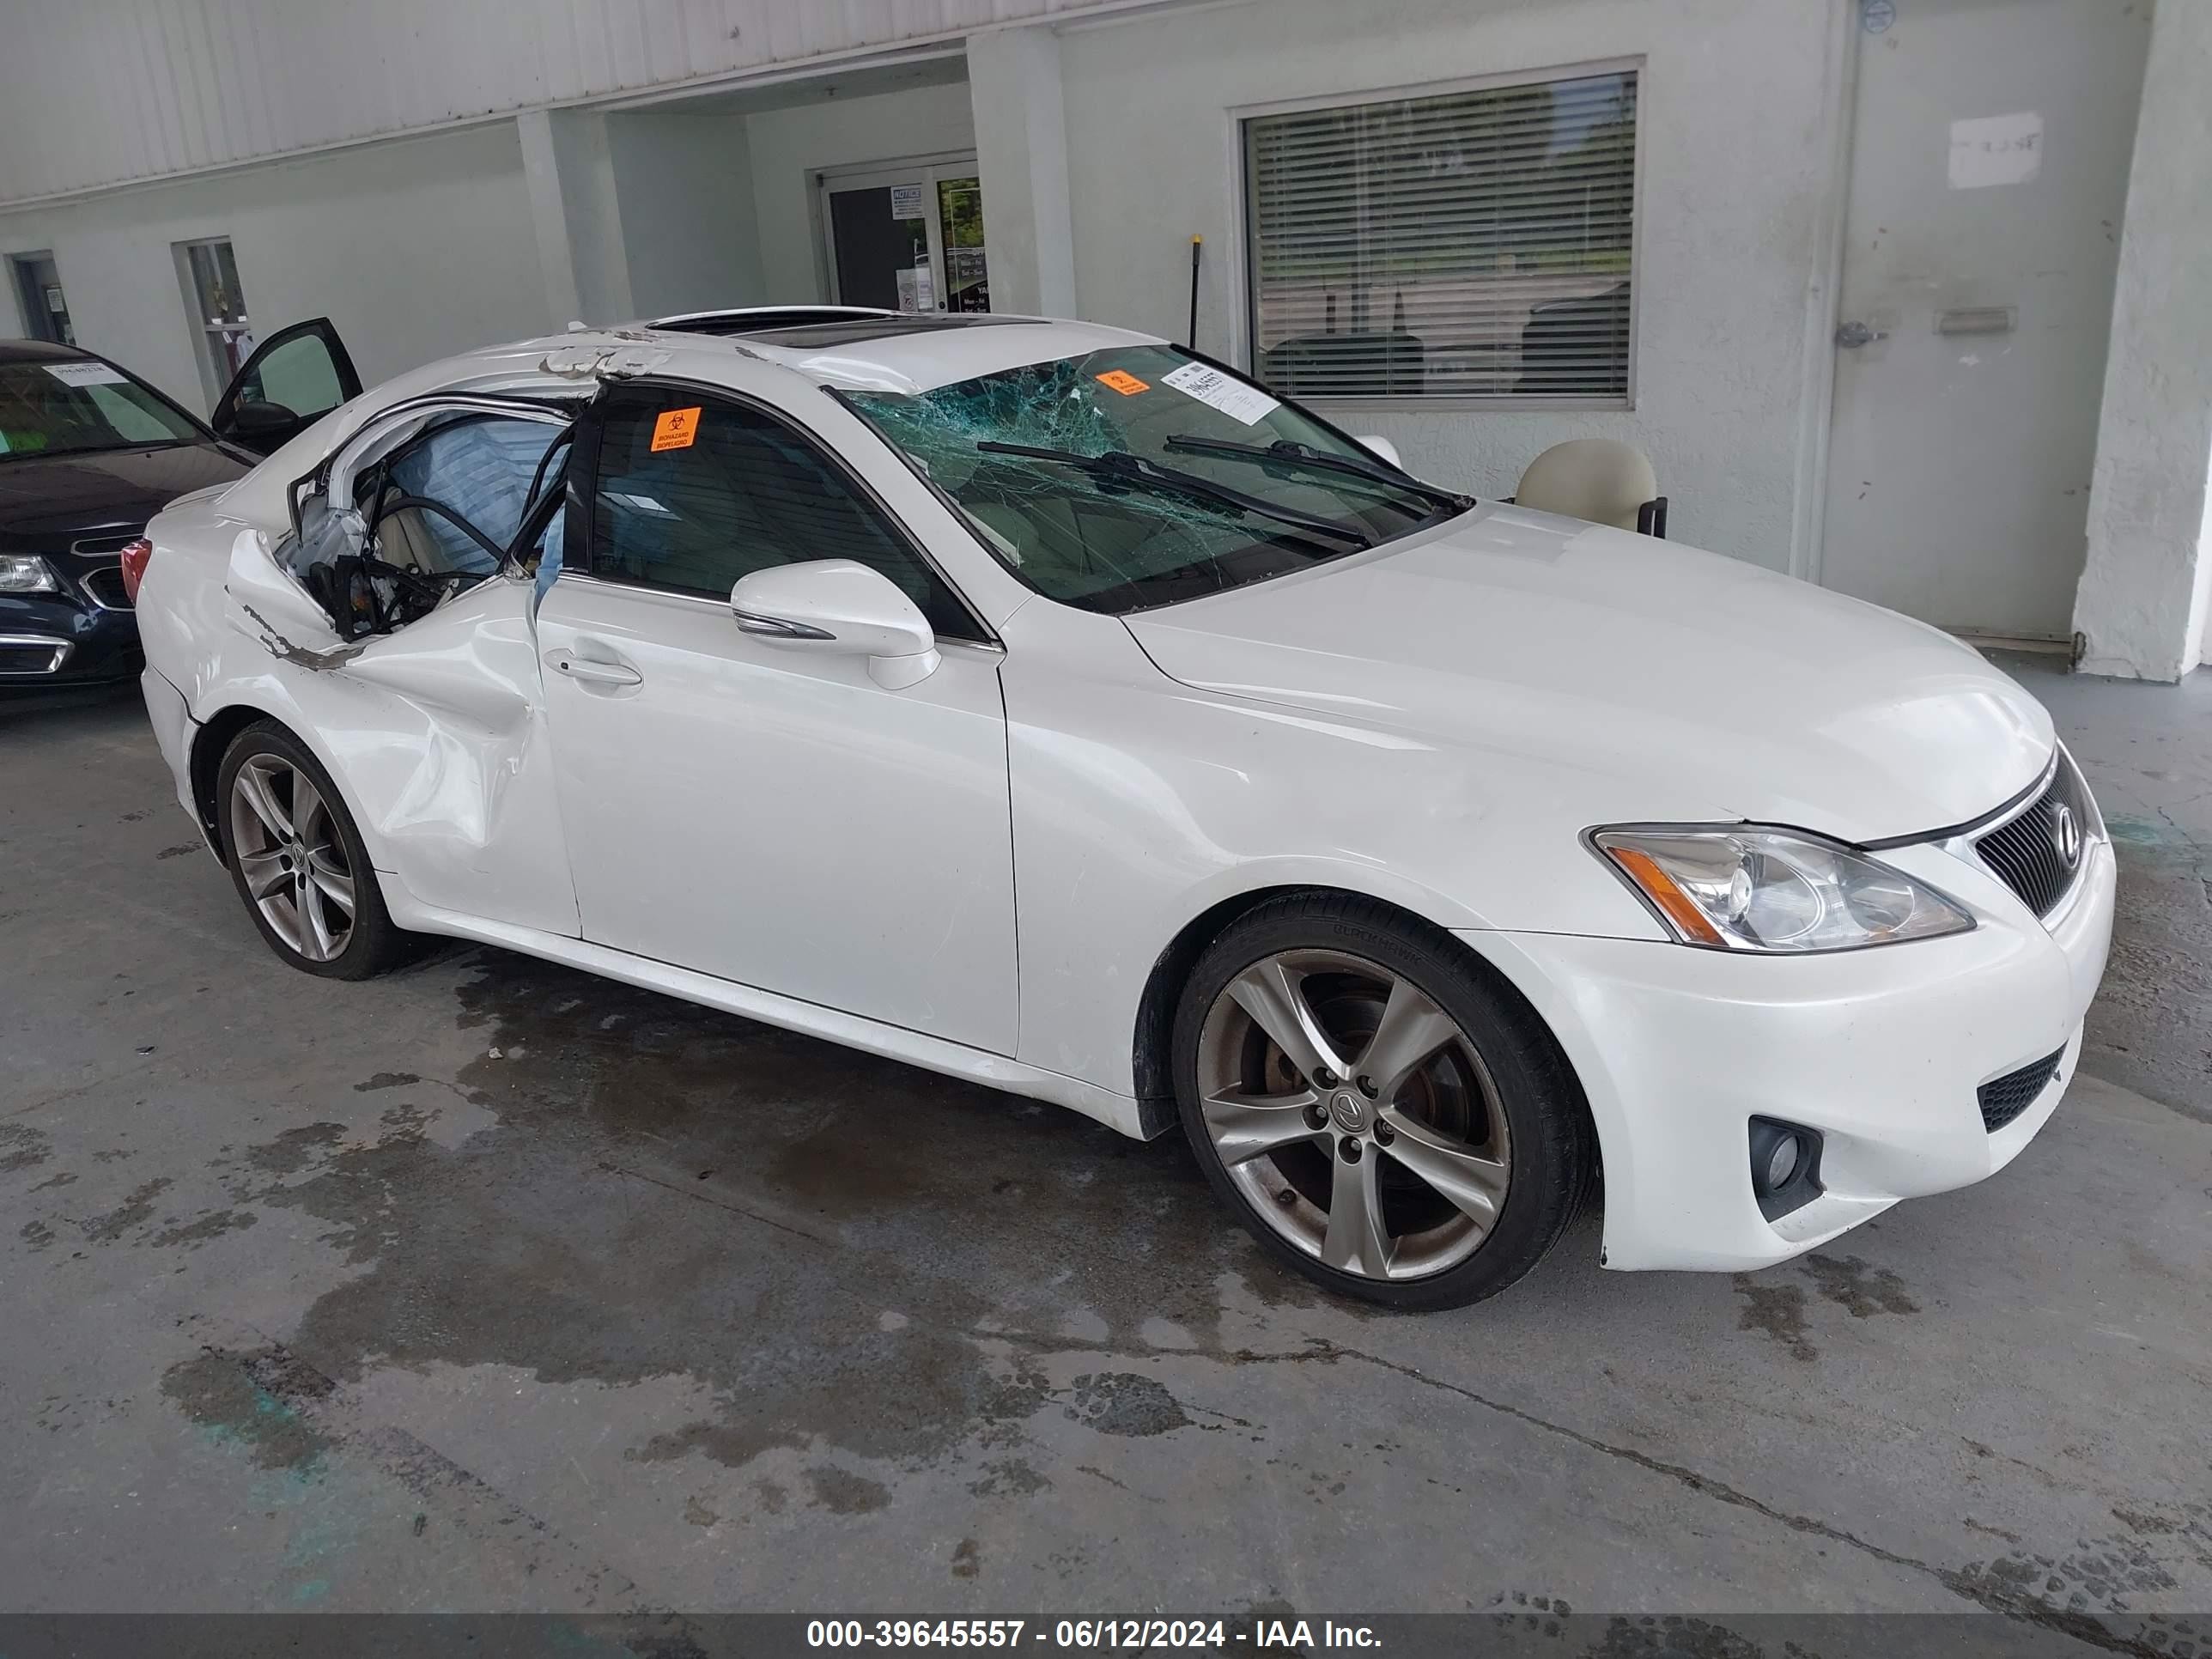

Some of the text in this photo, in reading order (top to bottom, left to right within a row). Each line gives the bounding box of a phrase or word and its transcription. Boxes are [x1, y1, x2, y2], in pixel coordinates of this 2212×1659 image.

[894, 190, 920, 198] NOTICE
[1186, 372, 1222, 395] 39645557
[658, 432, 689, 441] BIOHAZARD
[656, 439, 688, 449] BIOPELIGRO
